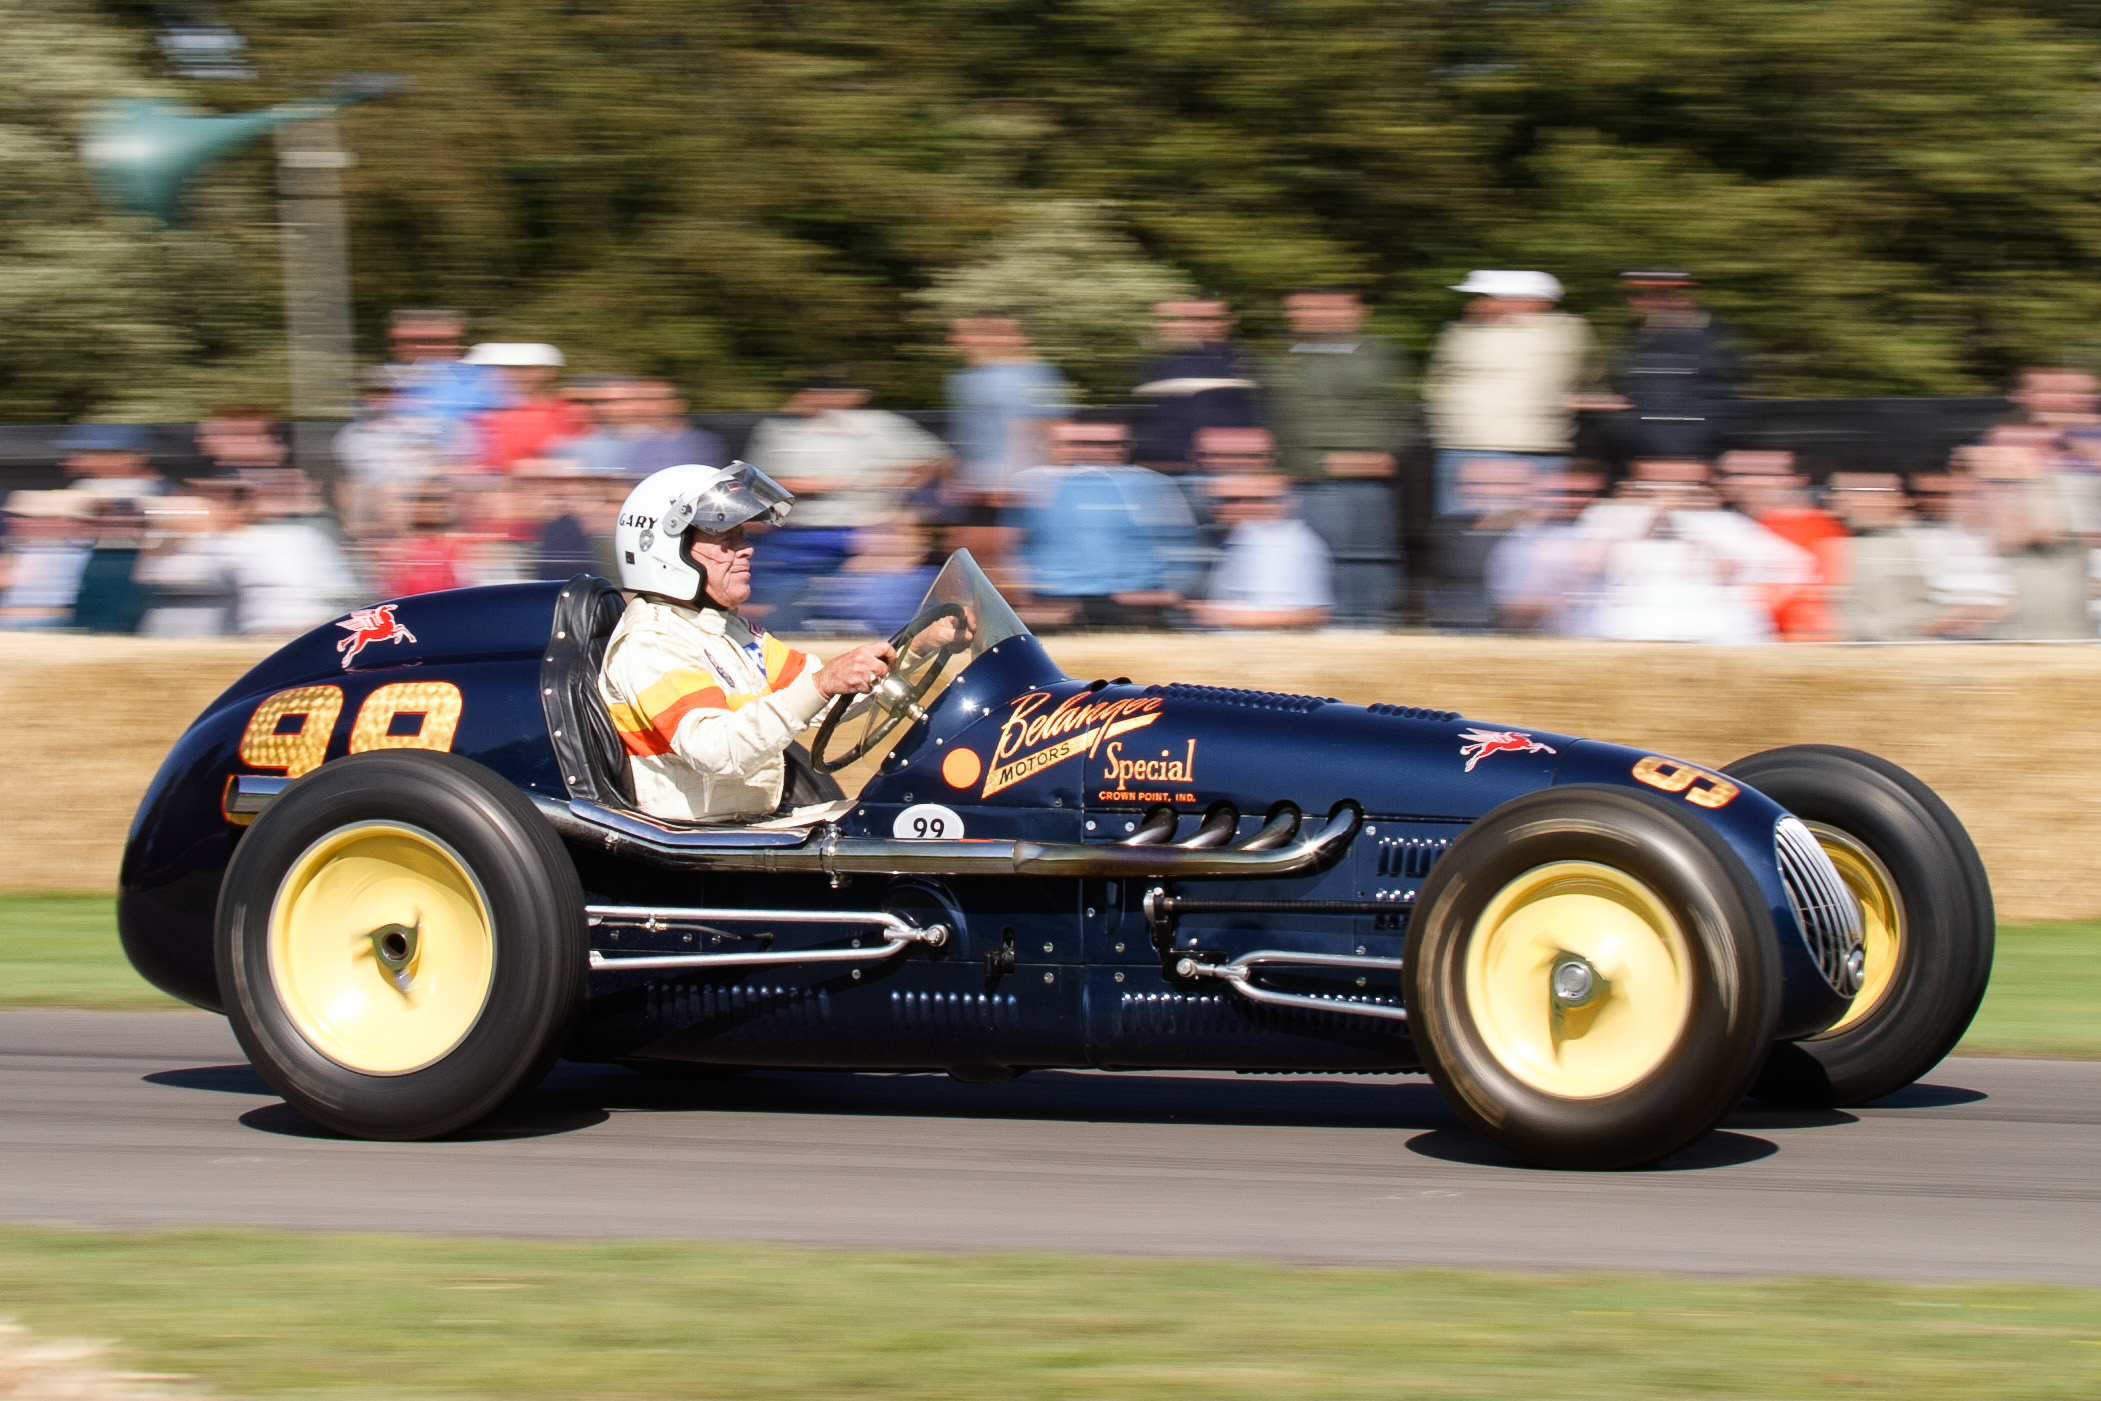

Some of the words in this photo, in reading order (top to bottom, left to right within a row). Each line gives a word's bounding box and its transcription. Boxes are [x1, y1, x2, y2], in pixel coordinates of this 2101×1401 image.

[619, 513, 659, 530] GARY
[1001, 690, 1164, 759] Belanger
[998, 742, 1070, 785] MOTORS
[1104, 738, 1196, 790] Special
[1098, 791, 1136, 801] CROWN
[1175, 793, 1197, 803] IND.
[913, 817, 945, 838] 99
